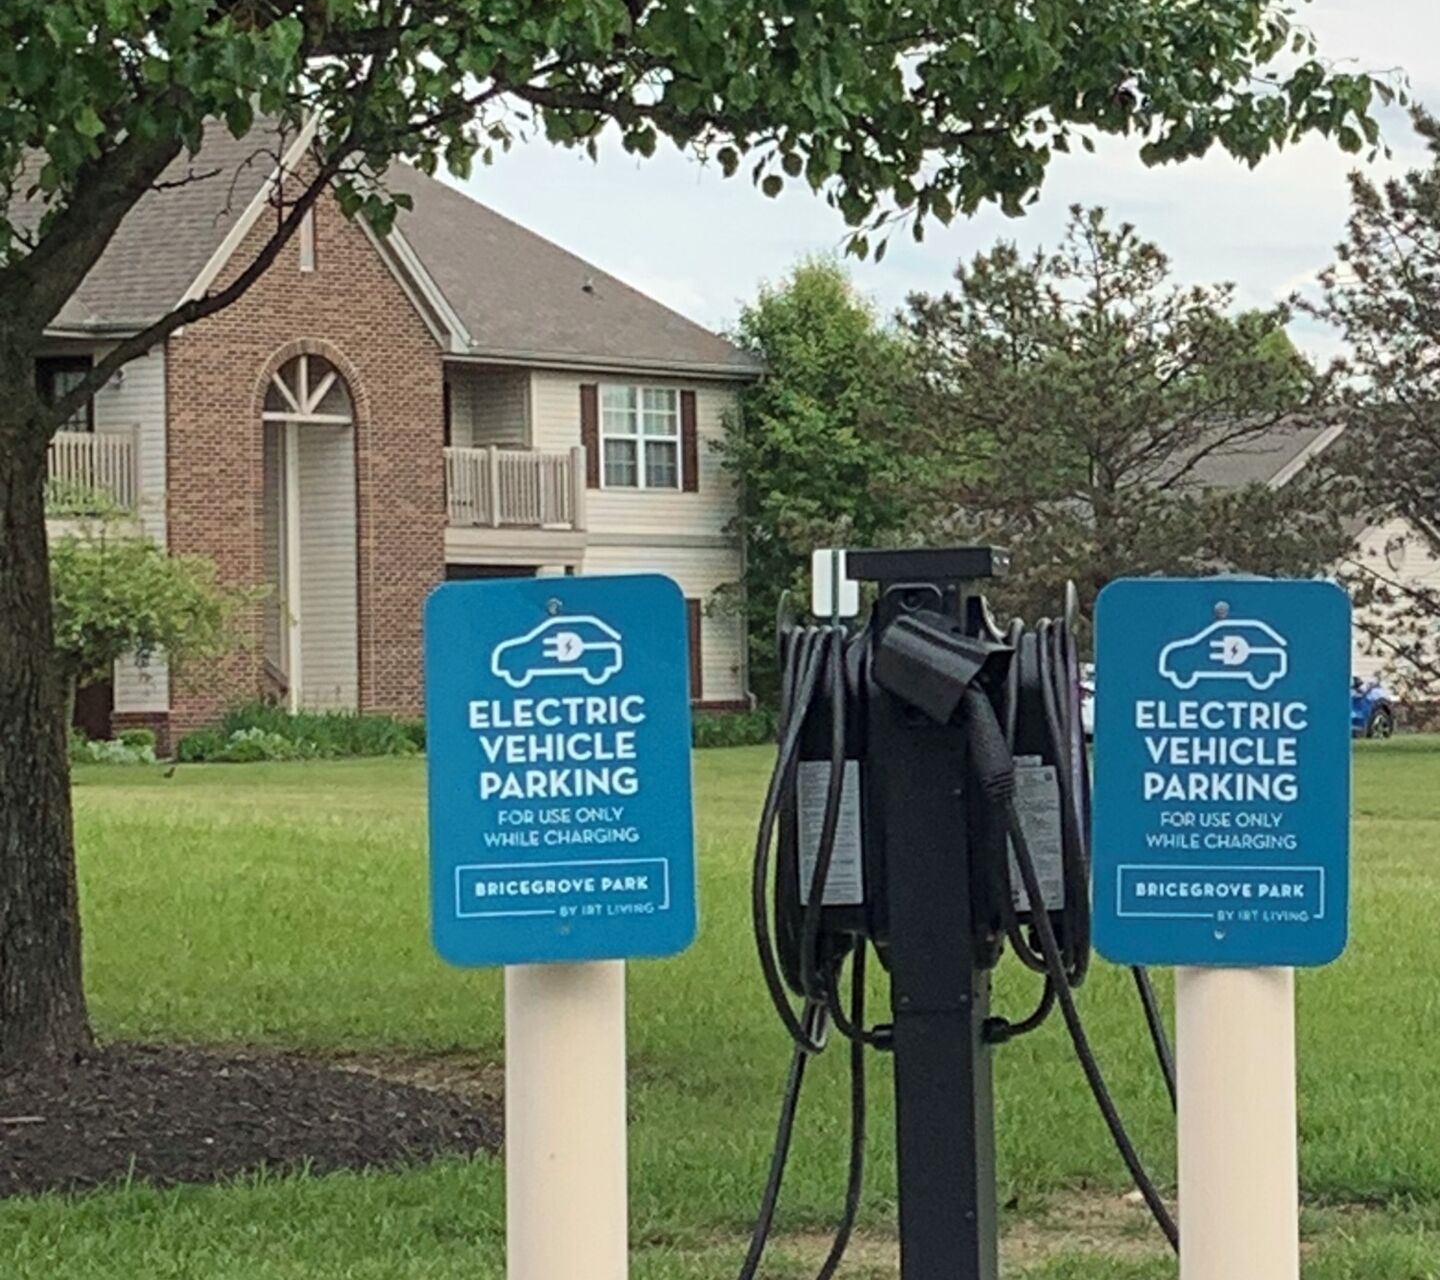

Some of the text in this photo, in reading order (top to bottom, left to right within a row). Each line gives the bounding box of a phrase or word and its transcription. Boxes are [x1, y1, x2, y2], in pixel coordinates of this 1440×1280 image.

[468, 695, 647, 730] ELECTRIC
[1134, 699, 1309, 731] ELECTRIC
[478, 730, 638, 764] VEHICLE
[1143, 736, 1299, 767] VEHICLE
[479, 766, 640, 801] PARKING
[1143, 771, 1300, 803] PARKING
[497, 806, 625, 826] FOR USE ONLY
[1160, 811, 1284, 829] FOR USE ONLY
[483, 826, 641, 848] WHILE CHARGING
[1145, 833, 1298, 851] WHILE CHARGING
[474, 875, 650, 897] BRICEGROVE PARK
[1134, 881, 1306, 899] BRICEGROVE PARK
